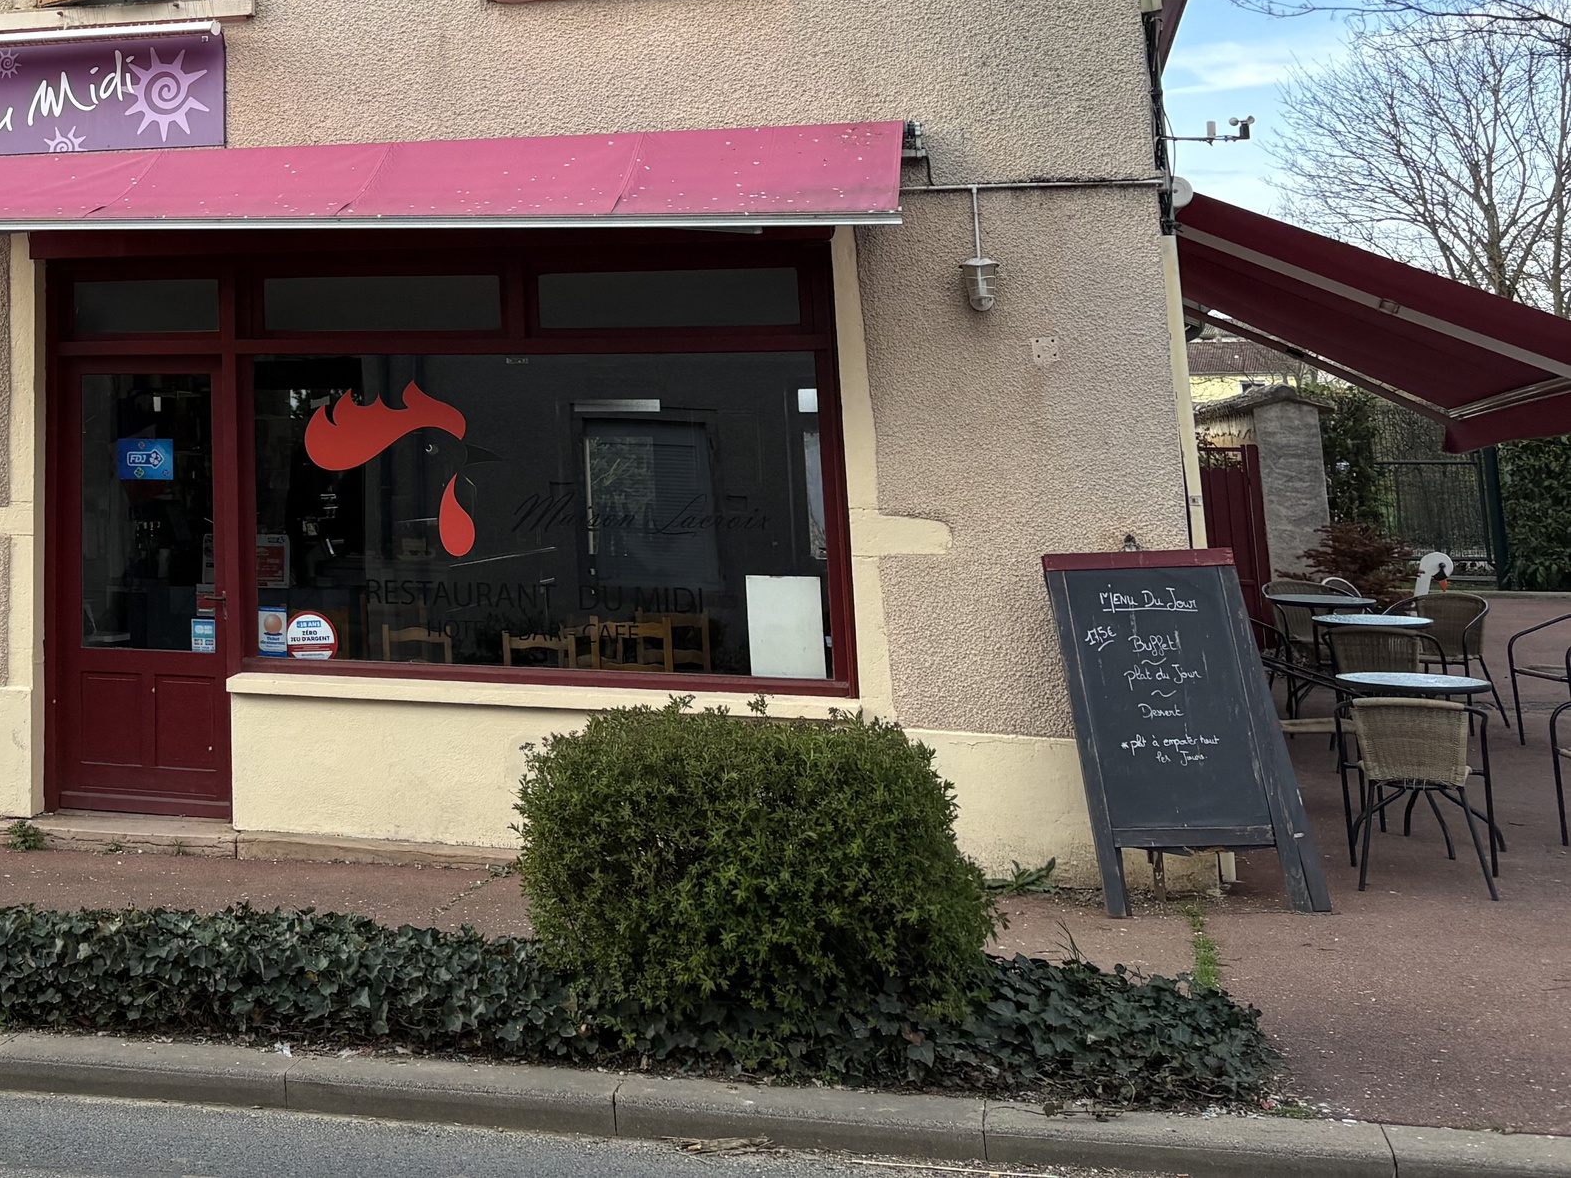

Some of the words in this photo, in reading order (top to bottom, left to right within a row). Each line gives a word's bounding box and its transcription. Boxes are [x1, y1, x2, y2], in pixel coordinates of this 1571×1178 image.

[27, 49, 136, 126] Midi
[129, 454, 147, 463] FDJ
[511, 492, 635, 533] Maison
[645, 493, 770, 535] Lacroix
[366, 579, 557, 610] RESTAURANT
[579, 585, 623, 612] DU
[635, 586, 703, 614] MIDI
[1141, 590, 1164, 607] Du
[1165, 587, 1197, 611] Jour
[1128, 635, 1178, 656] Buffet
[1156, 667, 1170, 680] du
[1172, 664, 1202, 683] Jour
[1138, 703, 1184, 719] Dessert
[1151, 735, 1160, 747] à
